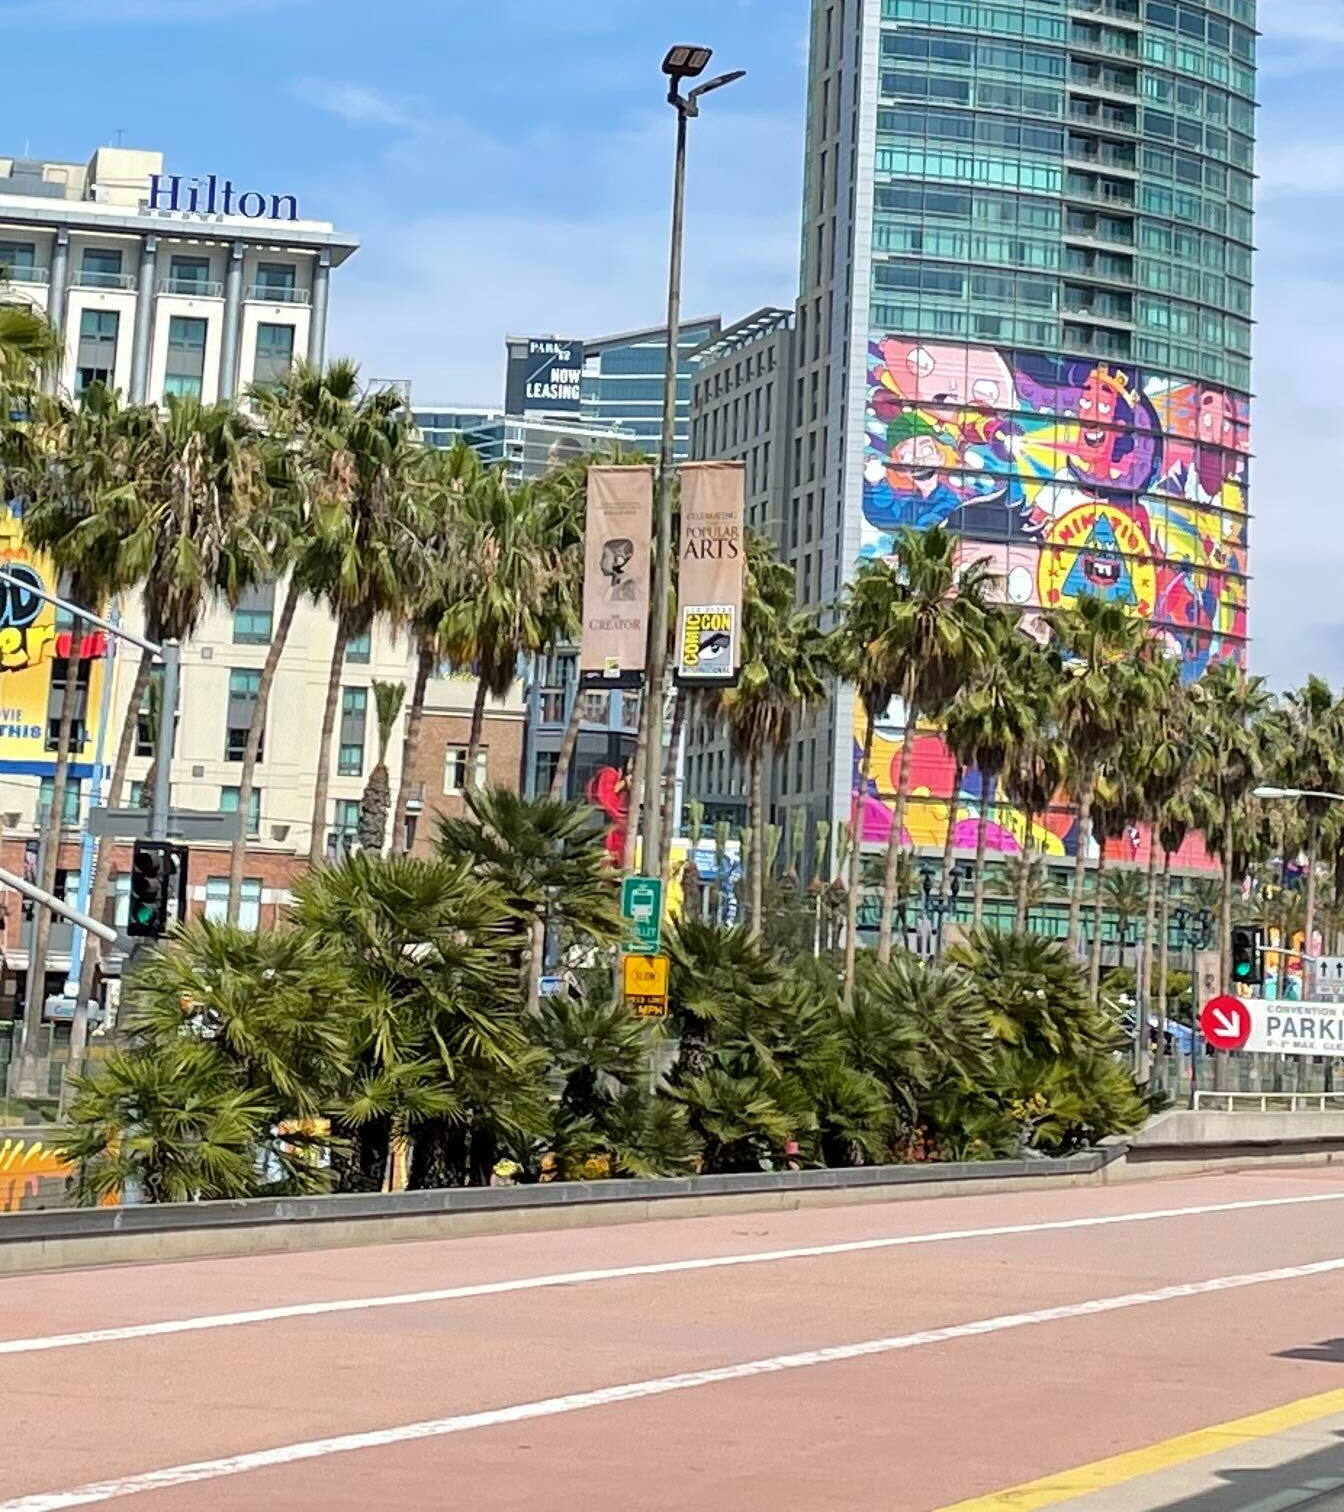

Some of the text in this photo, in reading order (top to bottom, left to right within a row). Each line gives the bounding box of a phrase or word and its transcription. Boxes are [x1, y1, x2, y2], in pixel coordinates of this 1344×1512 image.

[148, 174, 299, 221] Hilton
[550, 368, 581, 383] NOW
[526, 383, 580, 400] LEASING
[686, 526, 739, 539] POPULAR
[683, 538, 738, 560] ARTS
[701, 614, 731, 630] CON
[684, 614, 701, 666] COMIC
[1266, 1005, 1336, 1016] CONVENTION
